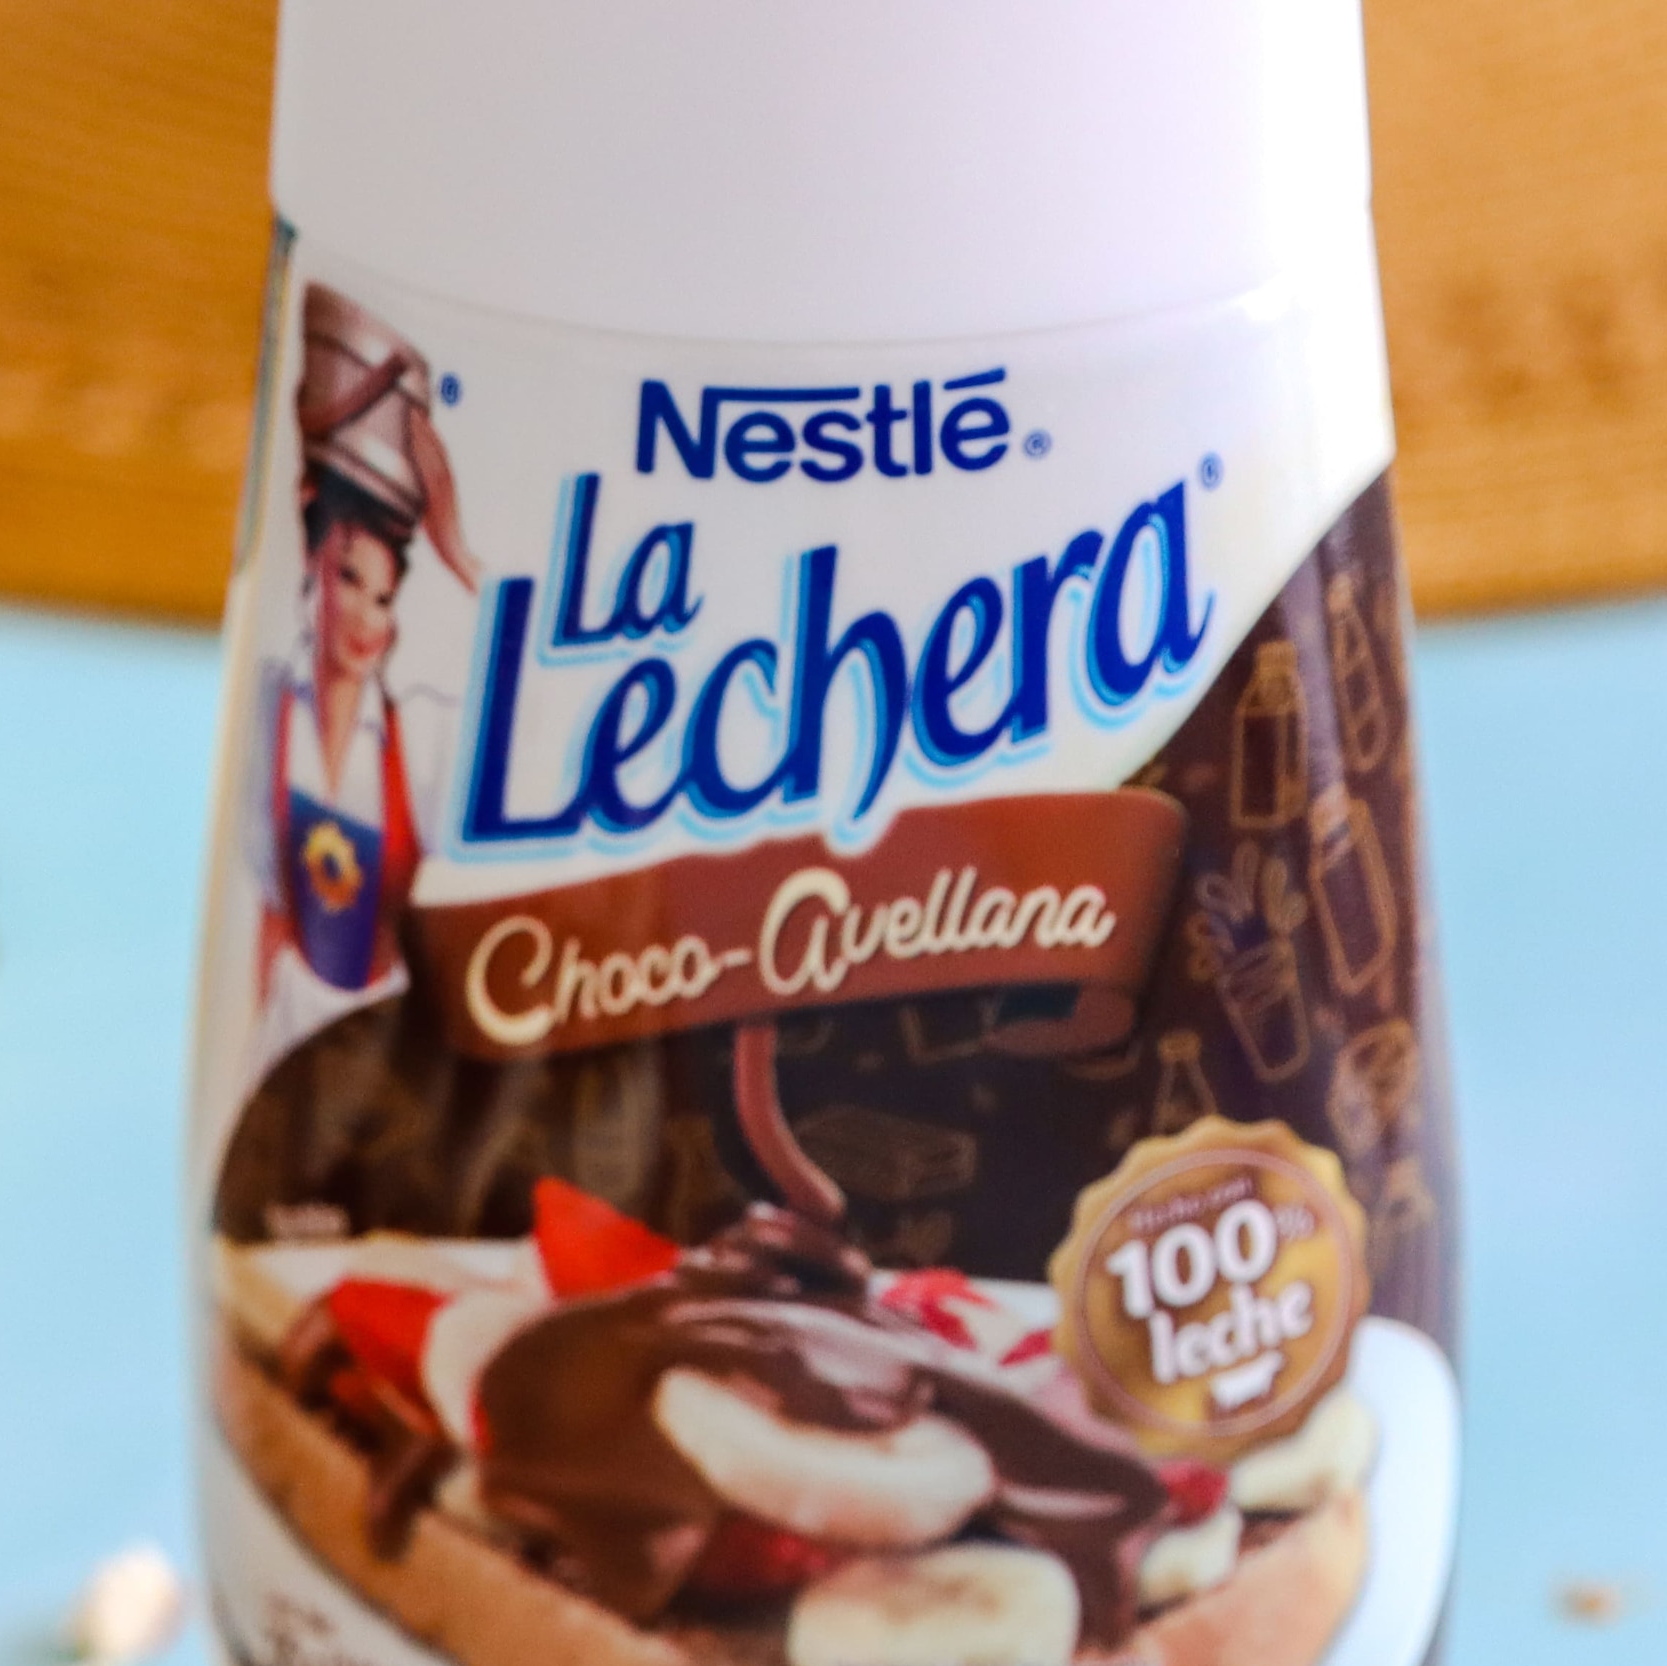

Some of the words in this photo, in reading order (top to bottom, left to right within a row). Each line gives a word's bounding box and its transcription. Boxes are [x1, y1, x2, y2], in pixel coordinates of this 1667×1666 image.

[635, 366, 1011, 484] Nestlé
[547, 470, 706, 650] La
[457, 478, 1216, 846] Lechera
[465, 866, 1117, 1047] Choco-Avellana
[1147, 1279, 1315, 1386] leche
